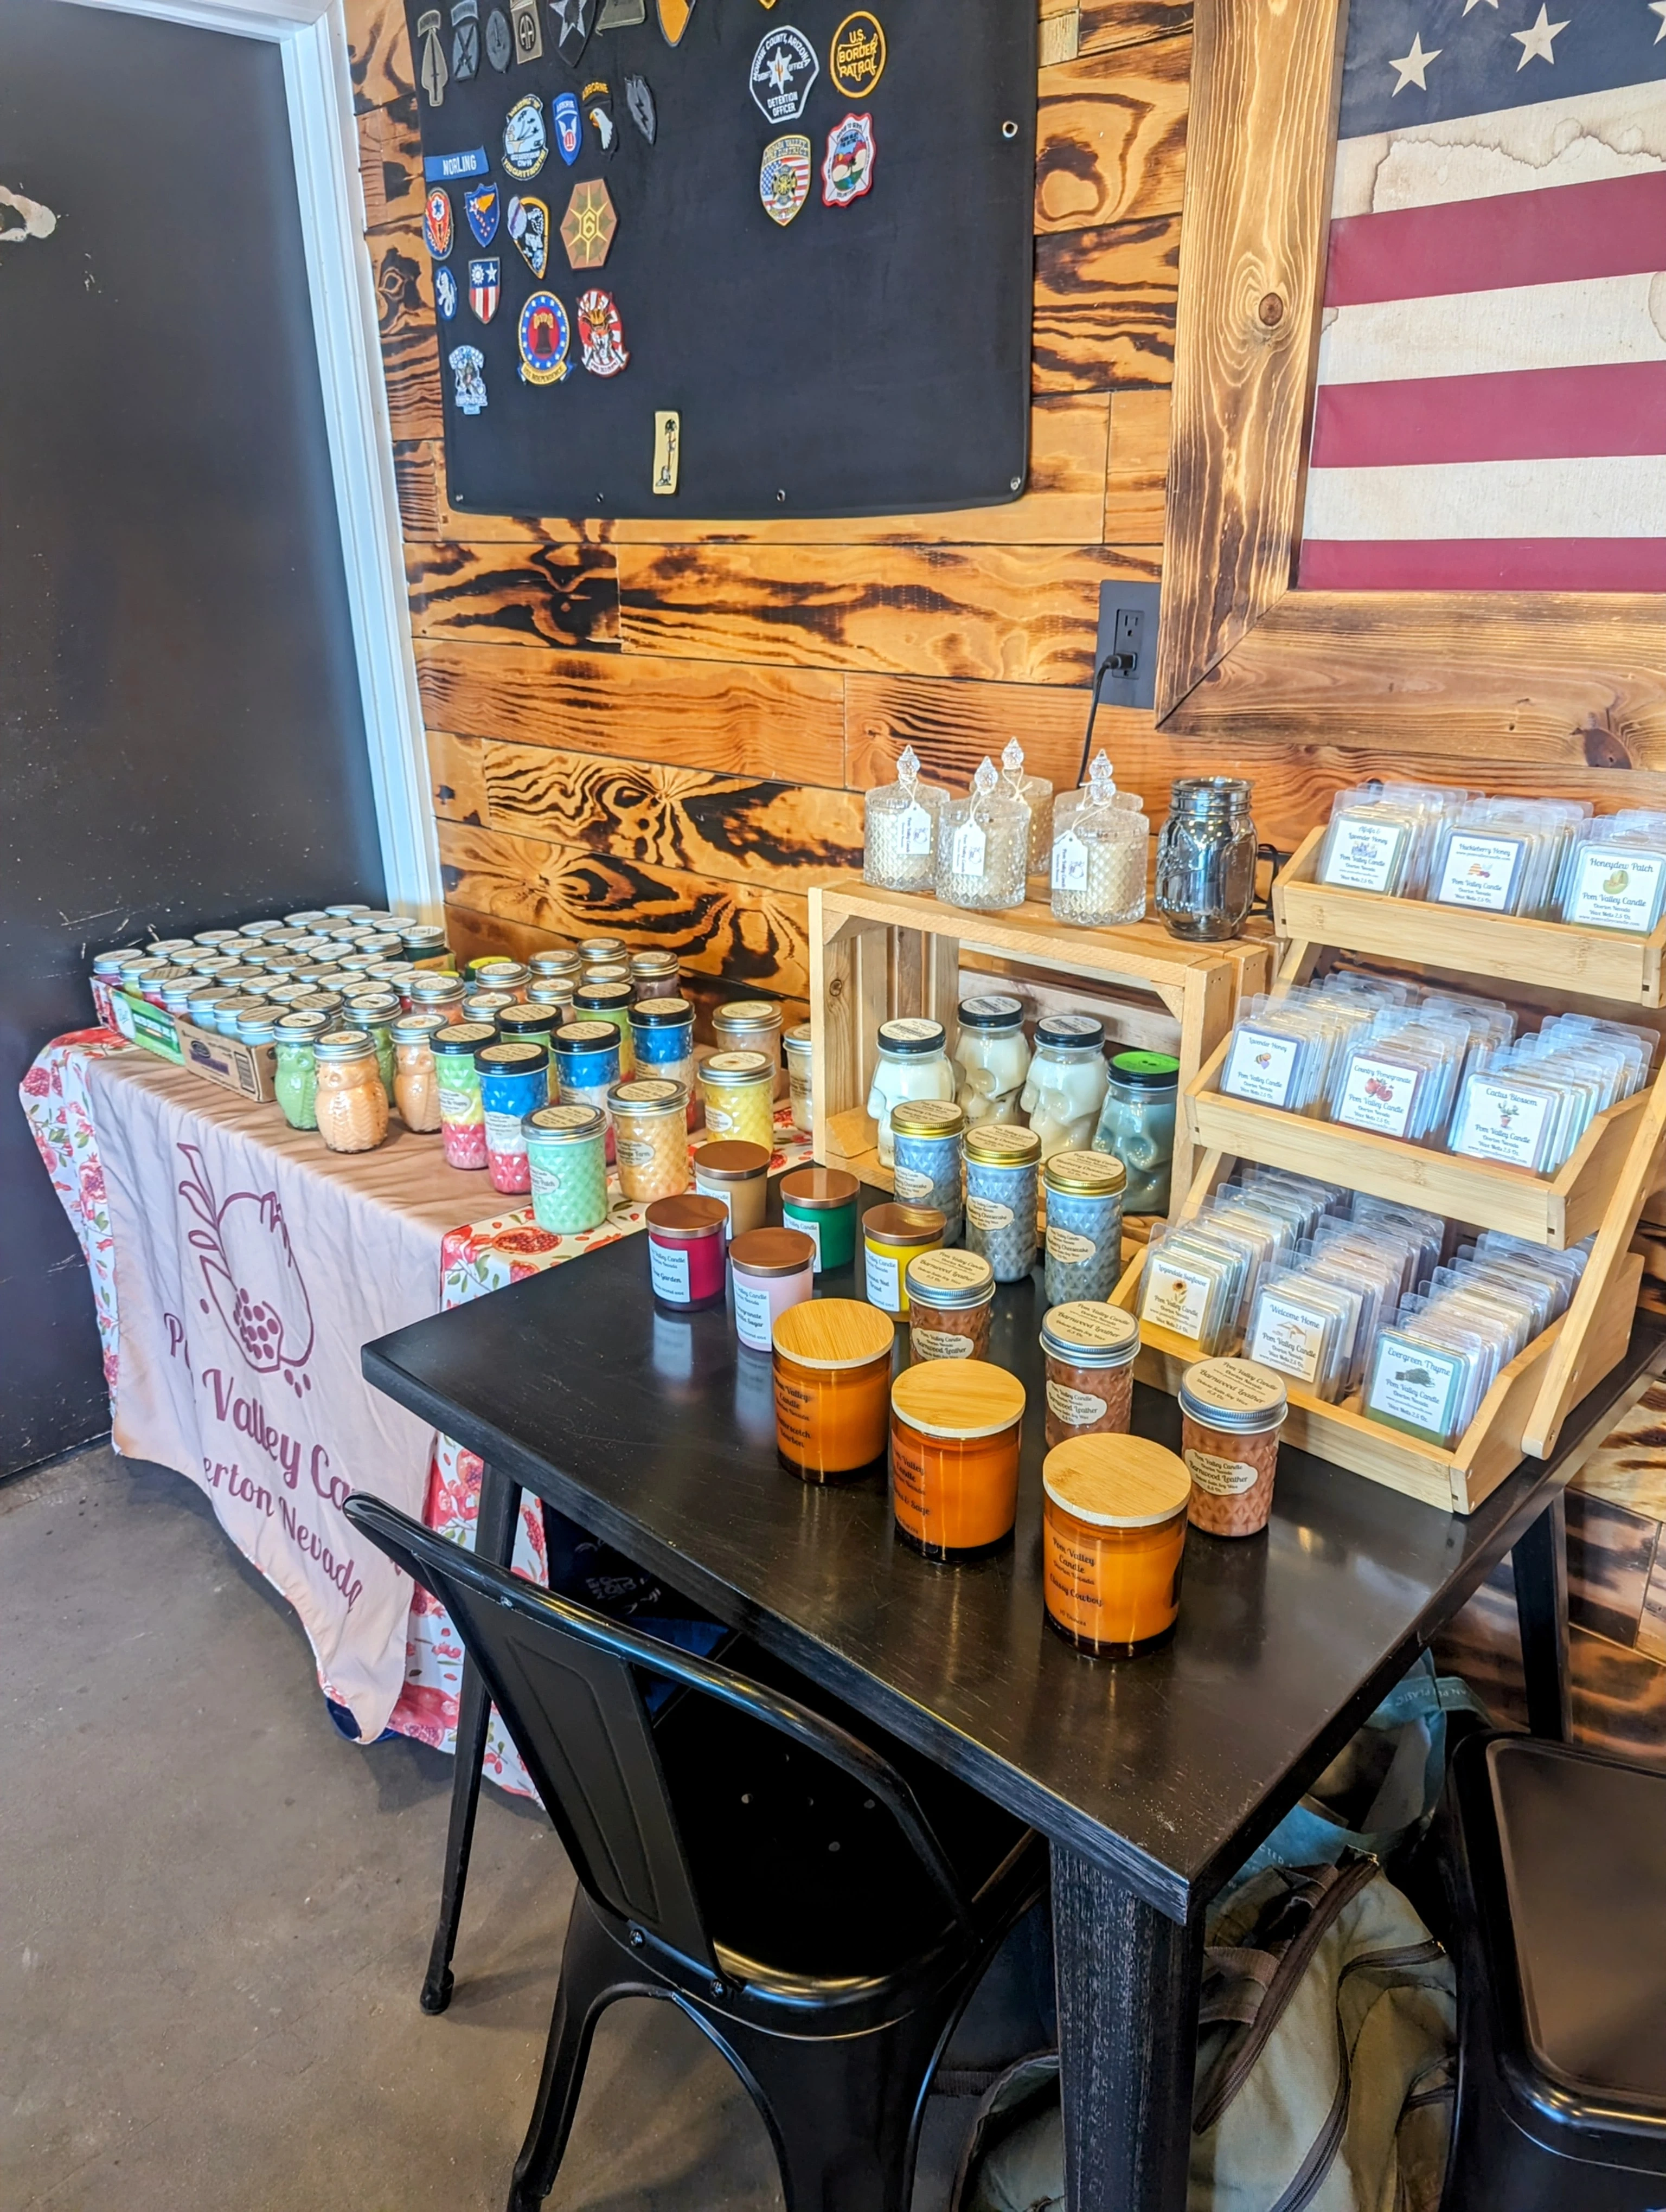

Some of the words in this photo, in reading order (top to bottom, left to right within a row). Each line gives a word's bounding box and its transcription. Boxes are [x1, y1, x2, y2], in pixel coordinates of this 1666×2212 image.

[849, 29, 866, 43] U.S.
[787, 35, 811, 67] ARIZONA
[839, 42, 876, 62] BORDER
[840, 59, 877, 77] PATROL
[767, 92, 798, 108] DETENTION
[772, 102, 796, 117] OFFICER
[443, 155, 477, 176] NORLING
[583, 210, 595, 239] 6
[1372, 836, 1388, 845] Honey
[1459, 844, 1491, 854] Huckleberry
[1494, 848, 1510, 857] Honey
[1352, 856, 1367, 865] Valley
[1368, 858, 1385, 866] Candle
[1590, 858, 1629, 870] Honeydew
[1631, 863, 1653, 872] Patch
[1465, 880, 1482, 889] Valley
[1582, 892, 1597, 901] Pom
[1599, 894, 1620, 905] Valley
[1623, 897, 1646, 906] Candle
[1249, 1037, 1270, 1047] Lavender
[1272, 1043, 1287, 1053] Honey
[1250, 1075, 1264, 1084] Valley
[1266, 1078, 1282, 1088] Candle
[1355, 1065, 1375, 1076] Country
[1376, 1070, 1412, 1084] Pomegranate
[1349, 1094, 1362, 1103] Pom
[1364, 1097, 1382, 1109] Valley
[1383, 1103, 1404, 1114] Candle
[1486, 1088, 1508, 1099] Cactus
[1509, 1093, 1537, 1106] Blossom
[1476, 1124, 1489, 1133] Pom
[1490, 1128, 1509, 1139] Valley
[1510, 1133, 1530, 1143] Candle
[879, 1259, 896, 1268] Candle
[920, 1259, 952, 1274] Barnwood
[952, 1271, 975, 1282] Leather
[952, 1256, 967, 1264] Valley
[967, 1262, 985, 1270] Candle
[661, 1273, 682, 1283] Garden
[1159, 1264, 1183, 1278] Logandale
[1184, 1274, 1207, 1287] Sunflower
[1155, 1295, 1165, 1303] Pom
[1167, 1299, 1181, 1311] Valley
[1182, 1306, 1198, 1318] Candle
[748, 1319, 764, 1328] Sugar
[1058, 1312, 1094, 1328] Barnwood
[1095, 1326, 1120, 1338] Leather
[1092, 1309, 1108, 1318] Valley
[1110, 1316, 1130, 1325] Candle
[1270, 1304, 1299, 1321] Welcome
[1300, 1315, 1319, 1329] Home
[917, 1339, 943, 1353] Barnwood
[1263, 1332, 1276, 1343] Pom
[1277, 1338, 1295, 1352] Valley
[1297, 1345, 1316, 1358] Candle
[1388, 1347, 1422, 1366] Evergreen
[1425, 1360, 1451, 1376] Thyme
[1223, 1362, 1237, 1371] Pom
[1238, 1368, 1256, 1380] Valley
[1257, 1378, 1278, 1390] Candle
[1226, 1369, 1244, 1380] Overton
[785, 1386, 809, 1403] Valley
[1060, 1389, 1073, 1399] Valley
[1200, 1369, 1238, 1391] Barnwood
[1238, 1389, 1265, 1404] Leather
[1386, 1379, 1399, 1388] Pom
[1401, 1384, 1418, 1397] Valley
[1420, 1391, 1440, 1404] Candle
[1049, 1392, 1073, 1411] Barnwood
[202, 1368, 301, 1489] Valley
[902, 1455, 925, 1476] Valley
[1189, 1460, 1221, 1481] Barnwood
[1222, 1475, 1248, 1483] Leather
[1205, 1458, 1222, 1469] Valley
[911, 1500, 931, 1516] Sage
[1053, 1537, 1066, 1554] Pom
[1067, 1548, 1095, 1567] Valley
[1059, 1554, 1085, 1573] Candle
[1050, 1573, 1069, 1596] Classy
[1070, 1589, 1103, 1607] Cowboy
[1067, 1613, 1086, 1626] Ounces
